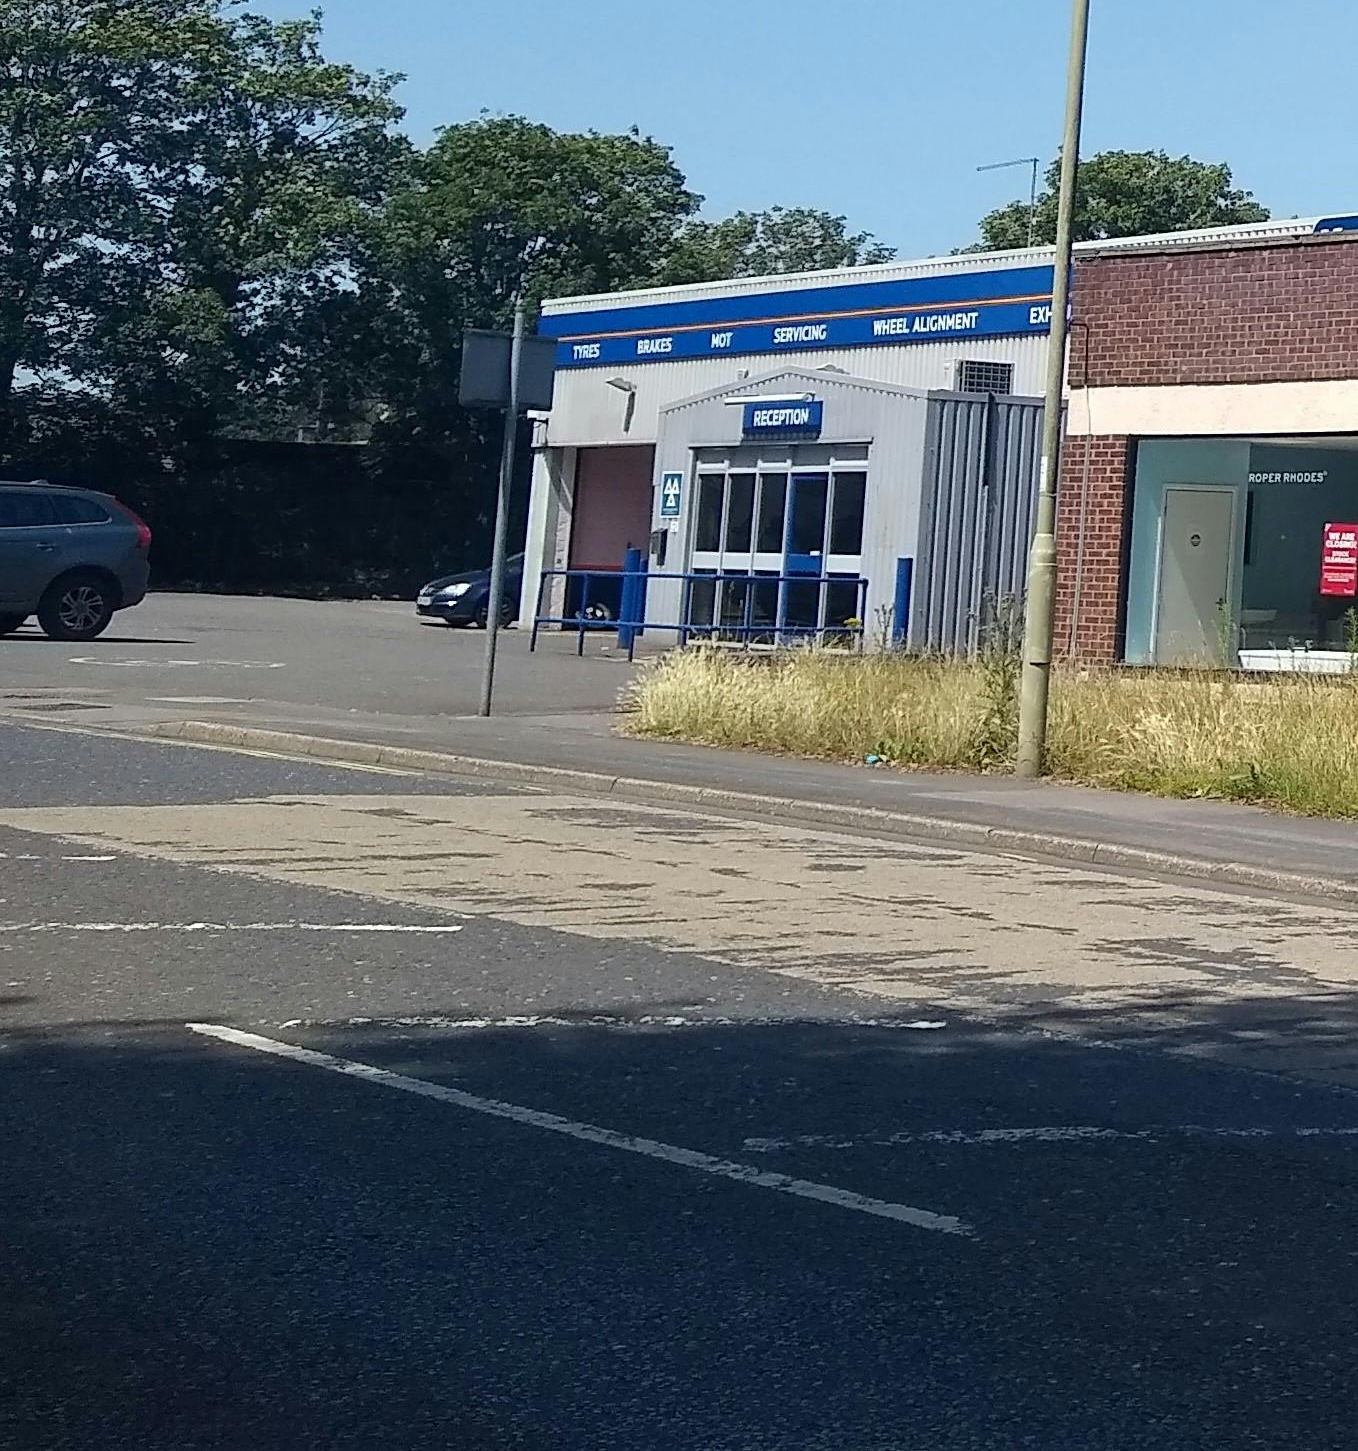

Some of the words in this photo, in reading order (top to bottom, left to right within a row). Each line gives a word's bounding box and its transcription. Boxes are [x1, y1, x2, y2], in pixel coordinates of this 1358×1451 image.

[573, 343, 600, 359] TYRES
[637, 337, 672, 355] BRAKES
[711, 332, 734, 348] MOT
[774, 324, 827, 344] SERVICING
[873, 317, 909, 336] WHEEL
[912, 312, 979, 333] ALIGNMENT
[753, 407, 809, 427] RECEPTION
[1248, 472, 1281, 483] ROPER
